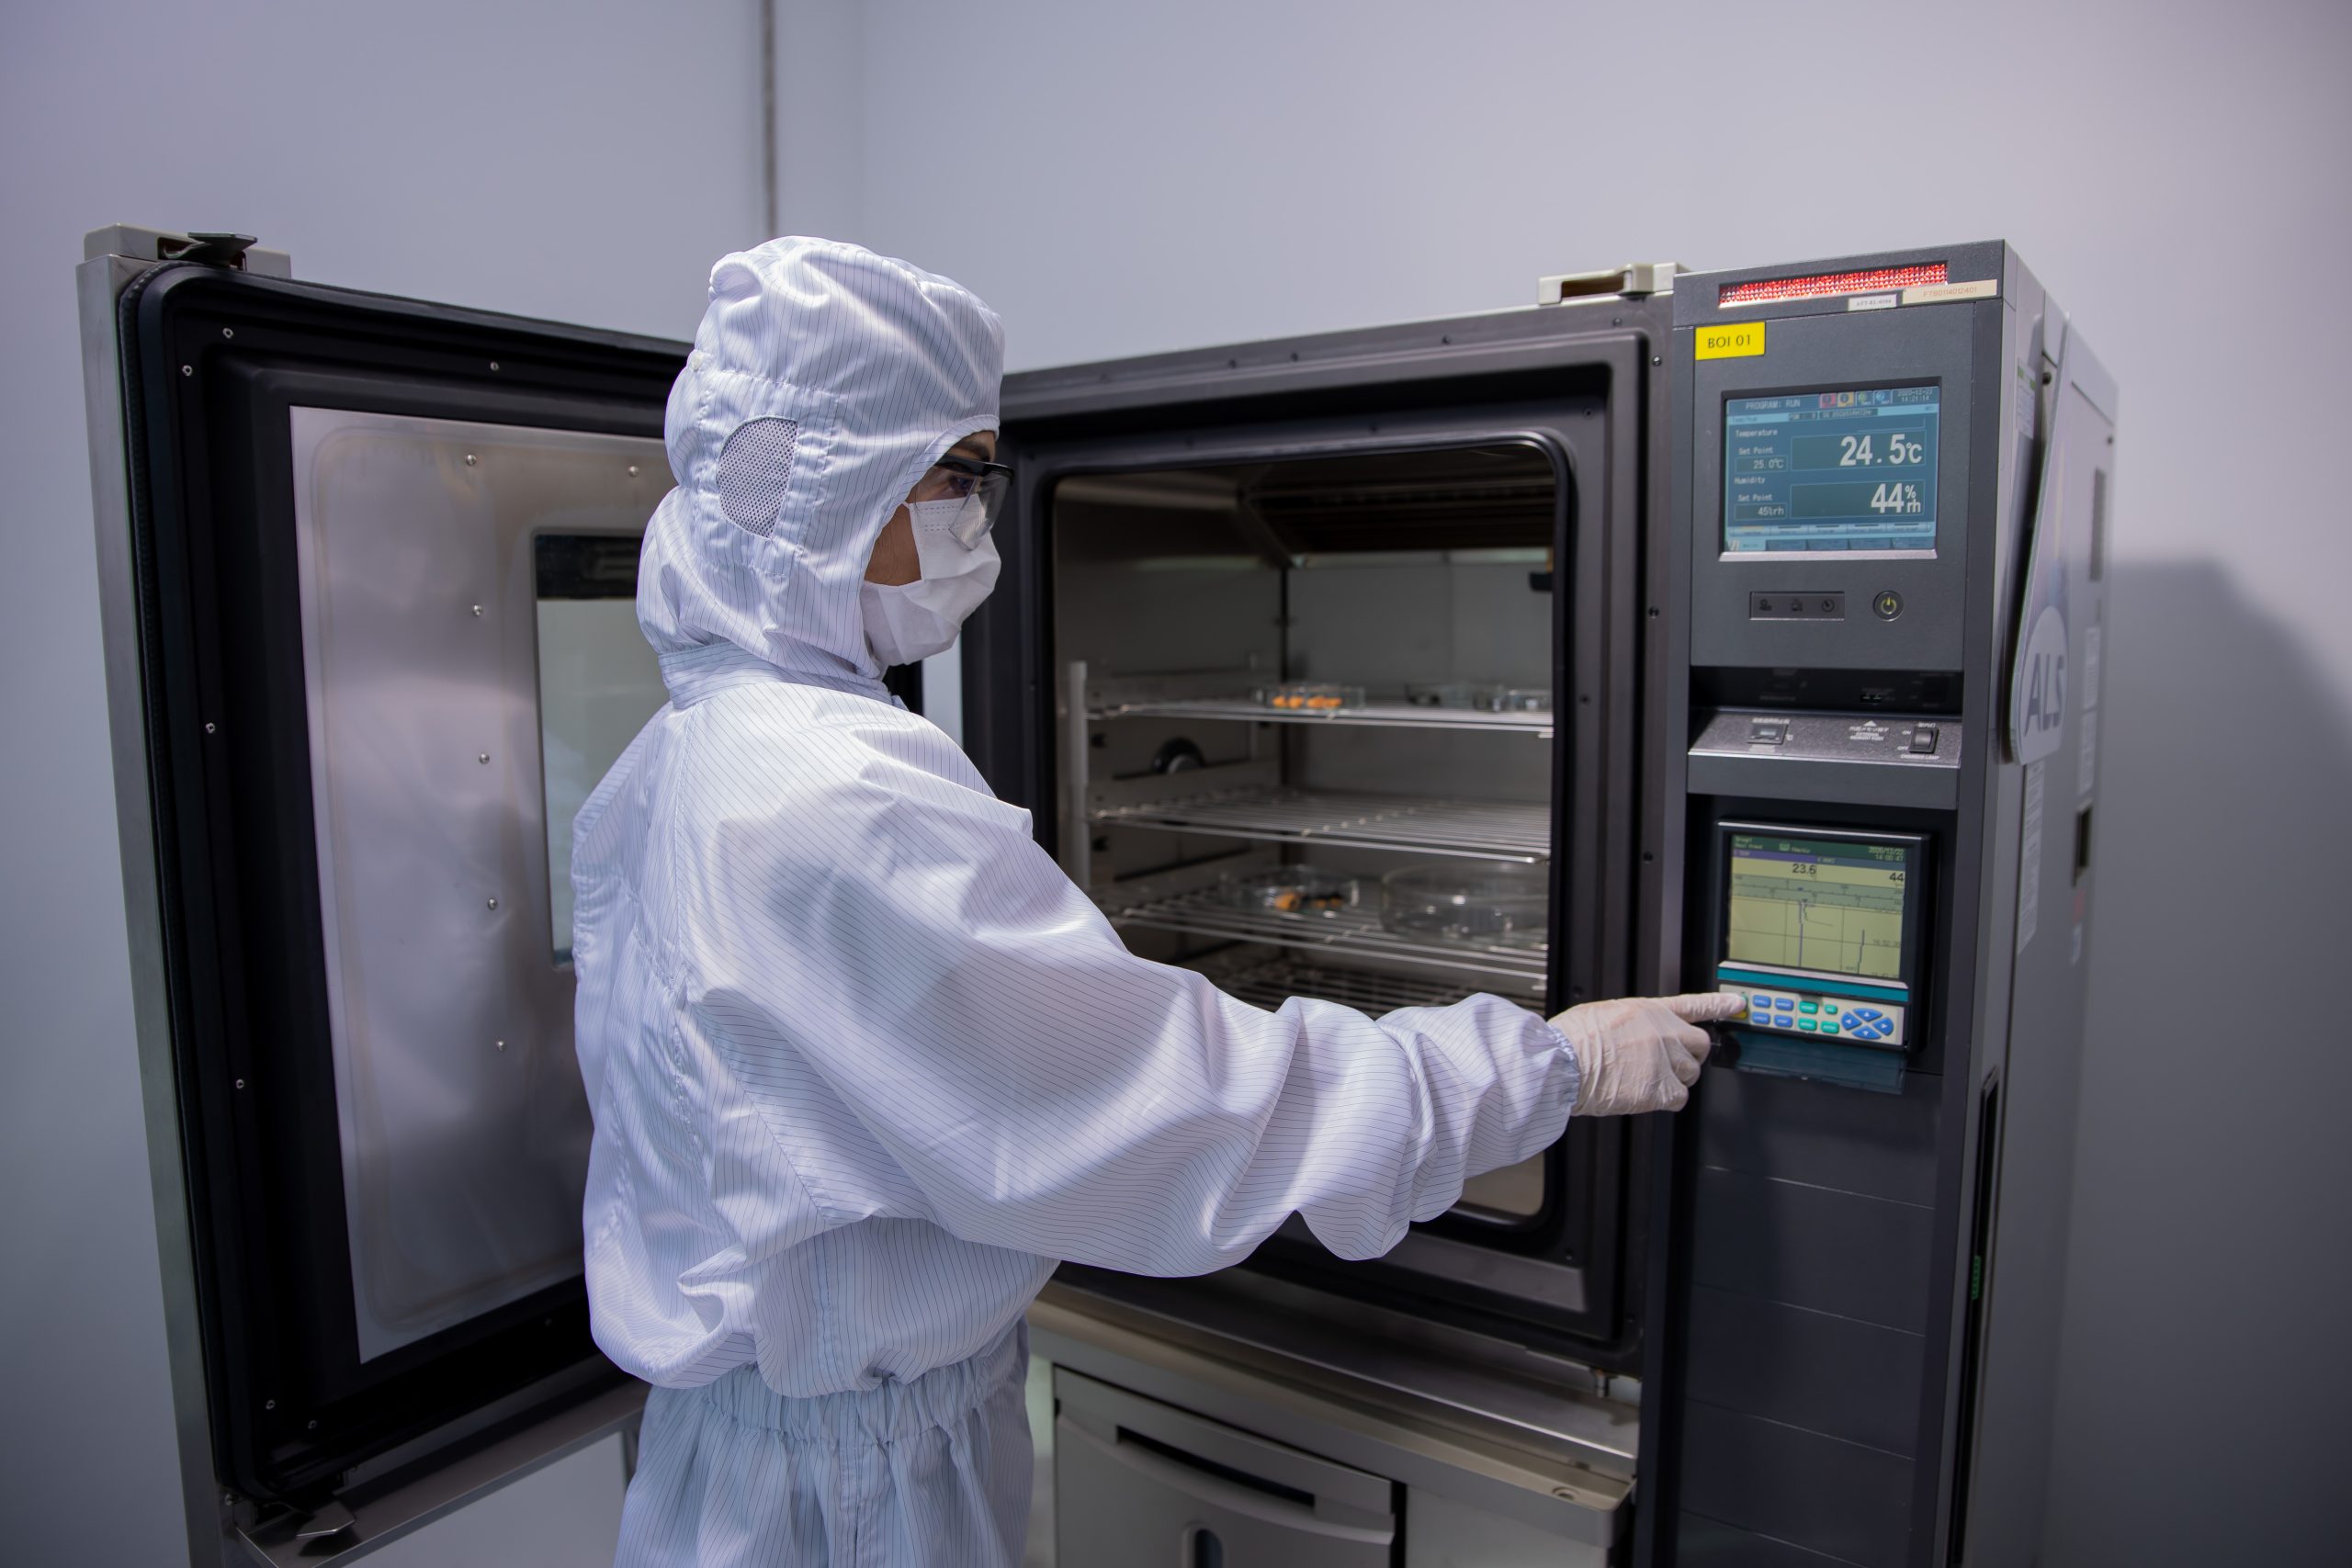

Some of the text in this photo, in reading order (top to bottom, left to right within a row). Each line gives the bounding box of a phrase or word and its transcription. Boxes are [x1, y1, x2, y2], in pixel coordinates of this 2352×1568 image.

[1708, 333, 1750, 349] BOI 01
[1785, 399, 1801, 408] RUN
[1736, 429, 1779, 438] Temperature
[1738, 446, 1774, 456] Set Point
[1734, 476, 1766, 485] Humidity
[1738, 493, 1773, 502] Set Point
[1871, 482, 1905, 513] 44
[2023, 653, 2064, 737] ALS
[1792, 863, 1817, 875] 23.6
[1889, 873, 1905, 883] 44
